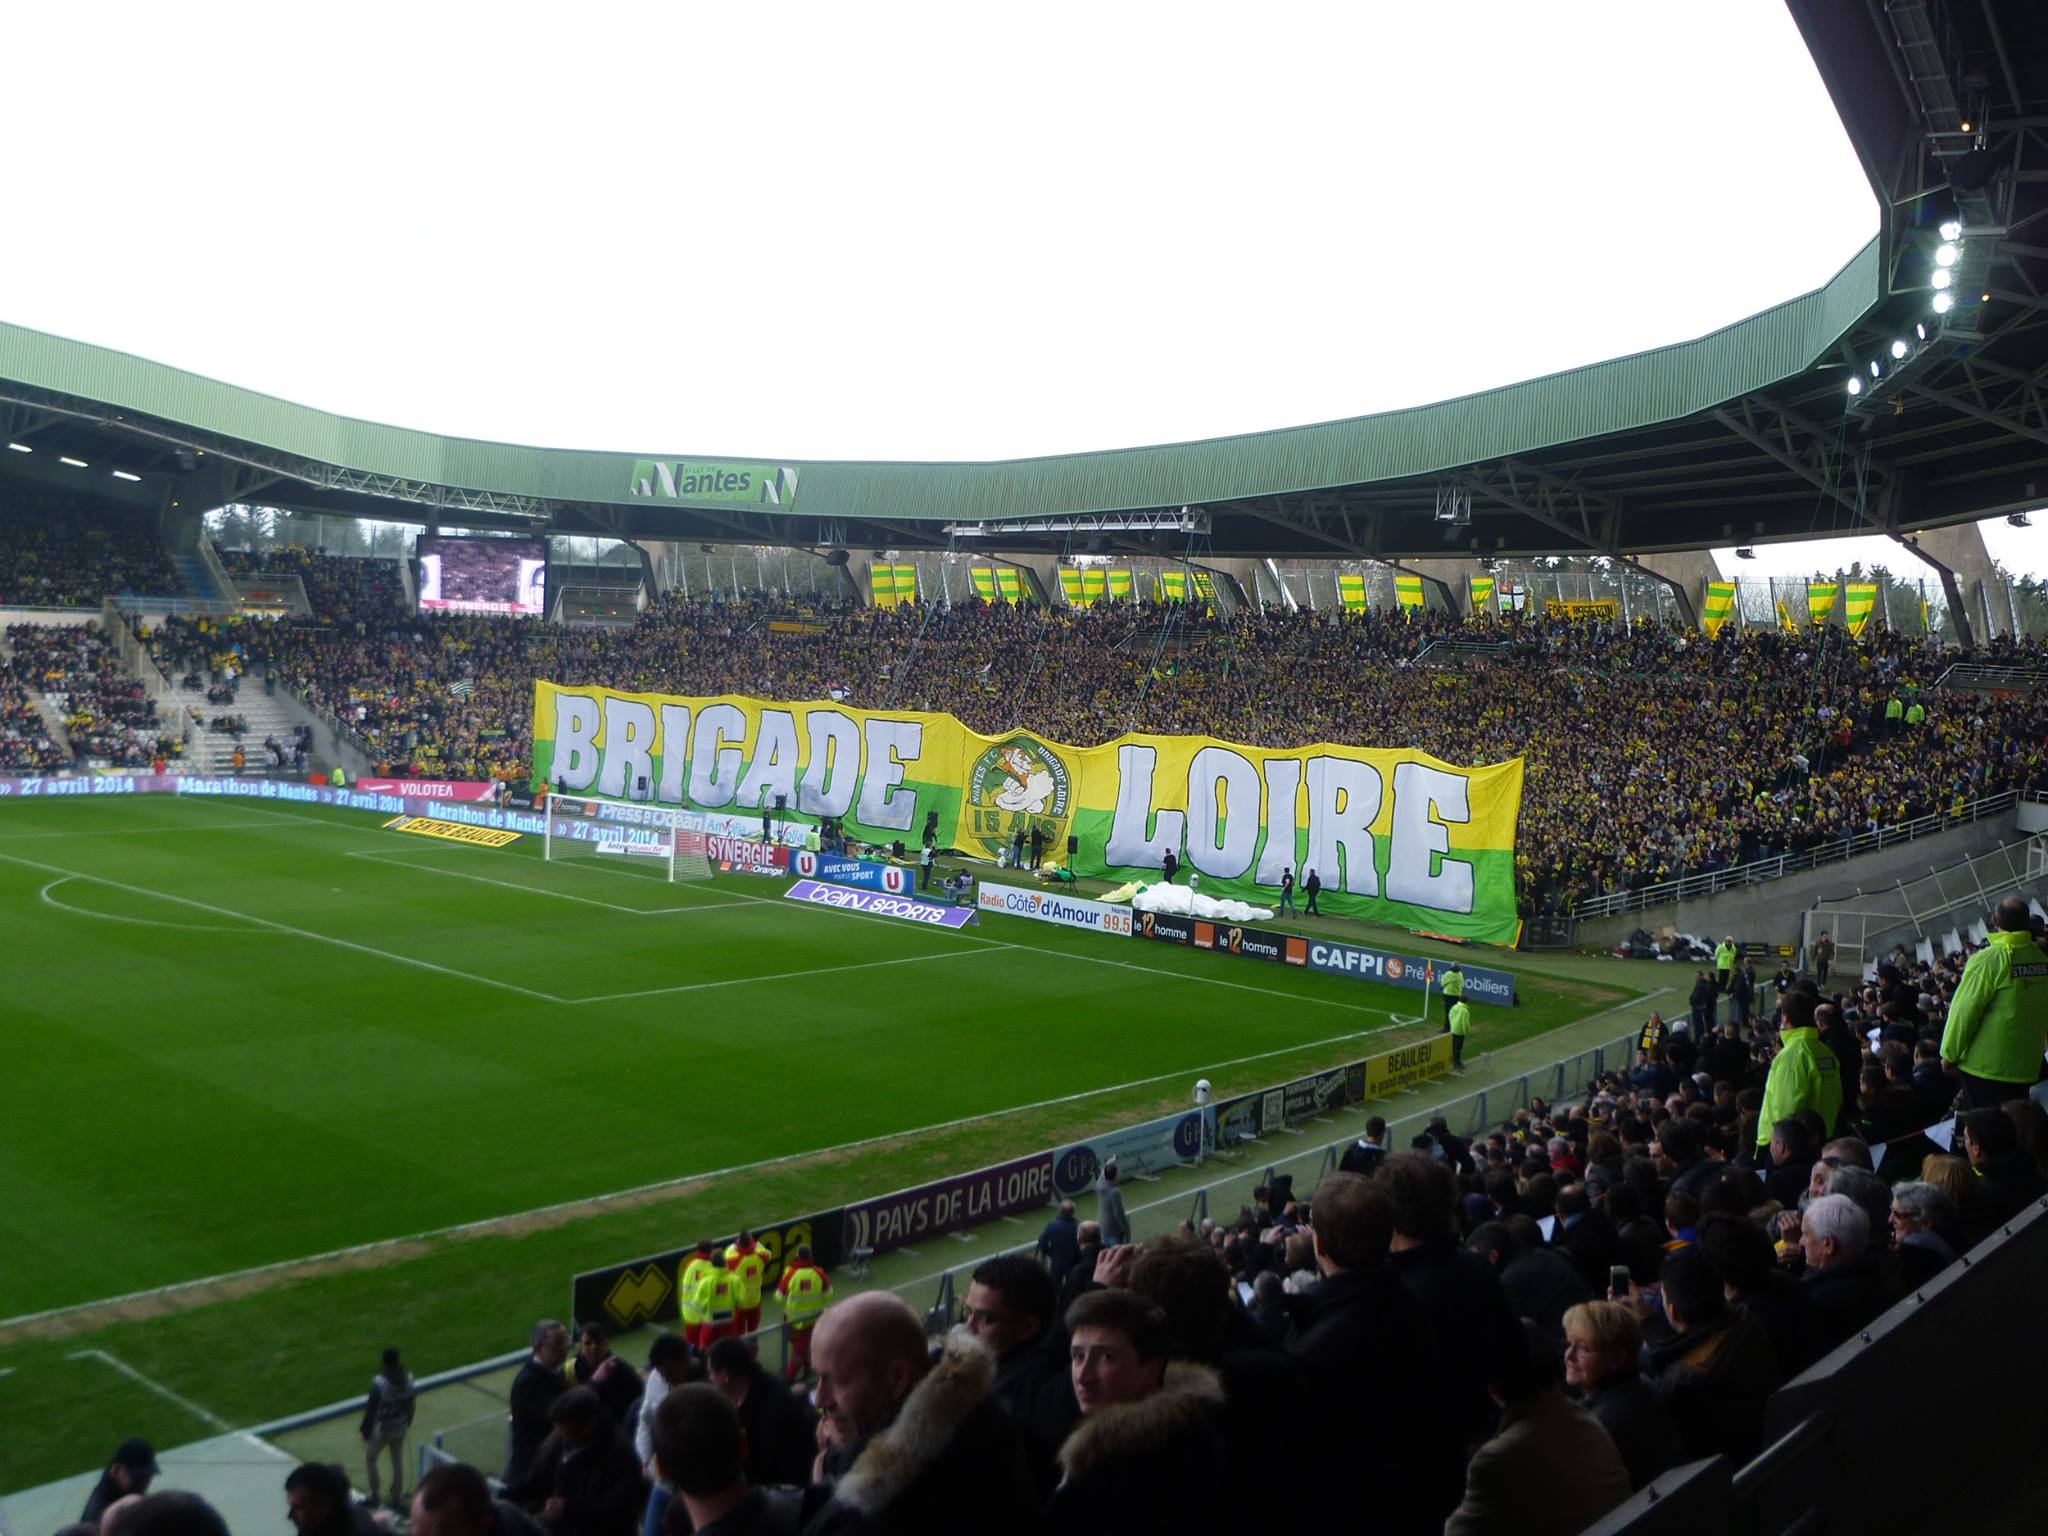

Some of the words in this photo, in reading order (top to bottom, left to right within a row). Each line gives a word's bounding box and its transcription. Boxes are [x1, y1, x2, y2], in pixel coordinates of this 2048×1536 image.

[651, 462, 751, 498] Nantes
[550, 692, 924, 832] BRIGADE
[1037, 746, 1067, 782] BRIGADE
[21, 778, 42, 795] 27
[47, 777, 90, 795] avril
[94, 776, 135, 794] 2014
[178, 776, 259, 797] Marathon
[261, 780, 276, 797] de
[278, 782, 319, 802] Nantes
[400, 782, 454, 798] VOLOTEA
[336, 789, 350, 806] 27
[351, 791, 378, 810] avril
[379, 794, 405, 813] 2014
[428, 801, 487, 826] Marathon
[489, 806, 504, 828] de
[507, 813, 549, 835] Nantes
[1104, 743, 1475, 914] LOIRE
[573, 821, 589, 839] 27
[591, 825, 625, 843] avril
[628, 828, 660, 846] 2014
[706, 836, 776, 866] SYNERGIE
[800, 856, 813, 874] U
[823, 864, 841, 874] AVEC
[842, 862, 860, 873] VOUS
[852, 870, 874, 881] SPORT
[886, 871, 899, 890] U
[870, 898, 946, 923] SPORTS
[980, 891, 1005, 908] Radio
[1041, 901, 1100, 925] d'Amour
[1103, 914, 1132, 934] 99.5
[1311, 944, 1383, 977] CAFPI
[1405, 963, 1435, 983] Prês
[1437, 969, 1510, 996] iobiliers
[1388, 1043, 1433, 1075] BEAULIEU
[875, 1197, 930, 1242] PAYS
[935, 1188, 963, 1225] DE
[968, 1182, 992, 1215] LA
[998, 1163, 1050, 1207] LOIRE
